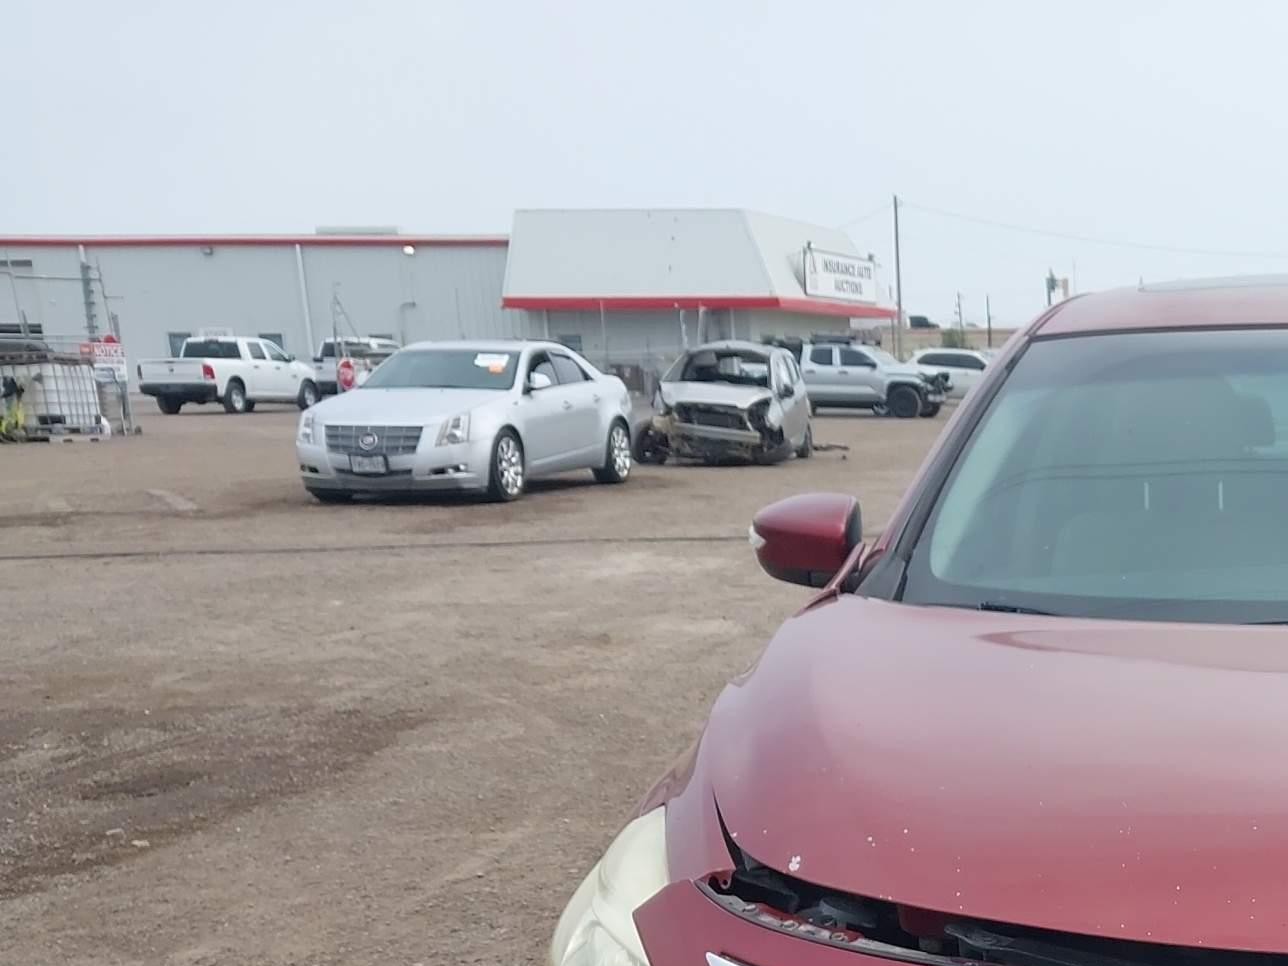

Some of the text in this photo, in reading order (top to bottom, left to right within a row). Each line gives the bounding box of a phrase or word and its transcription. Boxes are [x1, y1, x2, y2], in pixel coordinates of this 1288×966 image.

[823, 257, 872, 280] INSURANCE AUTO
[834, 278, 863, 296] AUCTIONS
[94, 344, 125, 358] NOTICE
